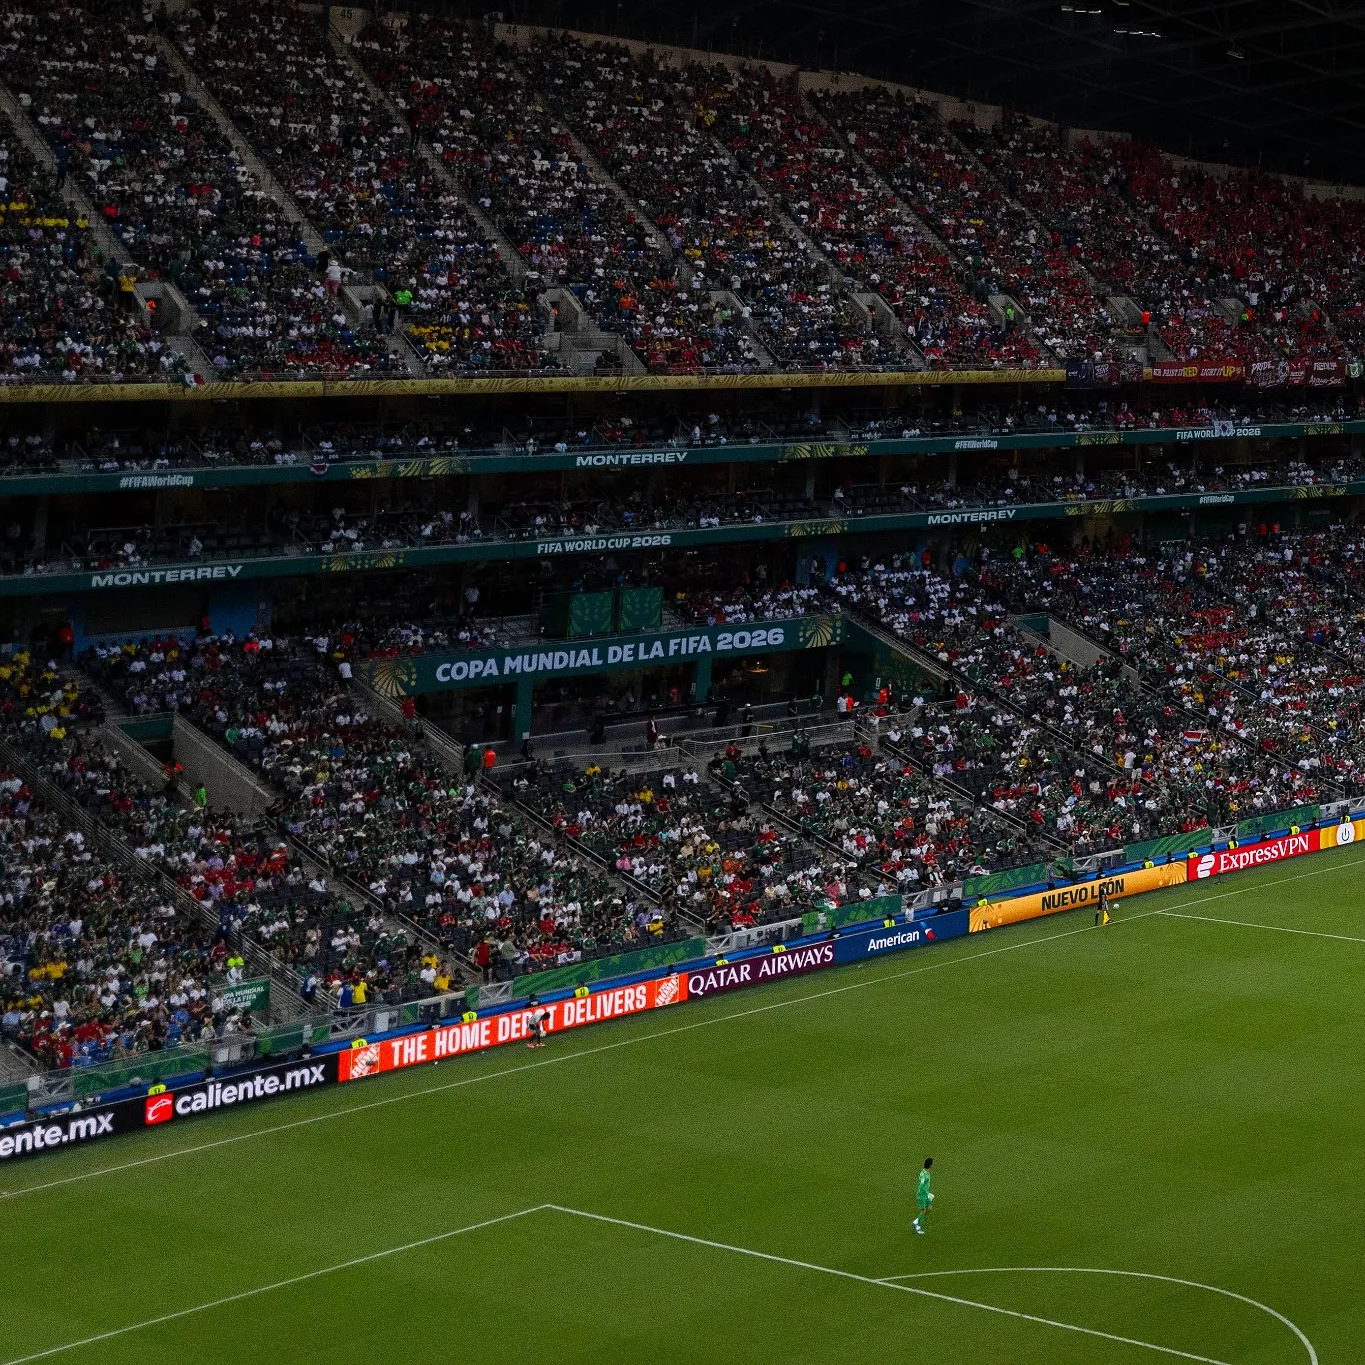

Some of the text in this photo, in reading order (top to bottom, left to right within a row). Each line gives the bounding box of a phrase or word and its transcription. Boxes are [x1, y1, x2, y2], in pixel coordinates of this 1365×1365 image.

[1183, 366, 1198, 377] RED
[1222, 365, 1236, 377] UP
[1176, 431, 1193, 440] FIFA
[1236, 428, 1261, 437] 2026
[576, 451, 688, 467] MONTERREY
[120, 476, 194, 489] #FIFAWorldCup
[928, 508, 1017, 525] MONTERREY
[537, 534, 672, 554] FIFA WORLD CUP 2026
[91, 565, 244, 589] MONTERREY
[435, 627, 785, 682] COPA MUNDIAL DE LA FIFA 2026
[1219, 834, 1309, 873] ExpressVPN
[1041, 886, 1088, 911] NUEVO
[867, 929, 920, 952] American
[688, 945, 834, 996] QATAR AIRWAYS
[391, 1032, 430, 1066] THE
[434, 1019, 491, 1058] HOME
[562, 986, 647, 1027] DELIVERS
[174, 1063, 327, 1115] caliente.mx
[0, 1112, 115, 1158] ente.mx
